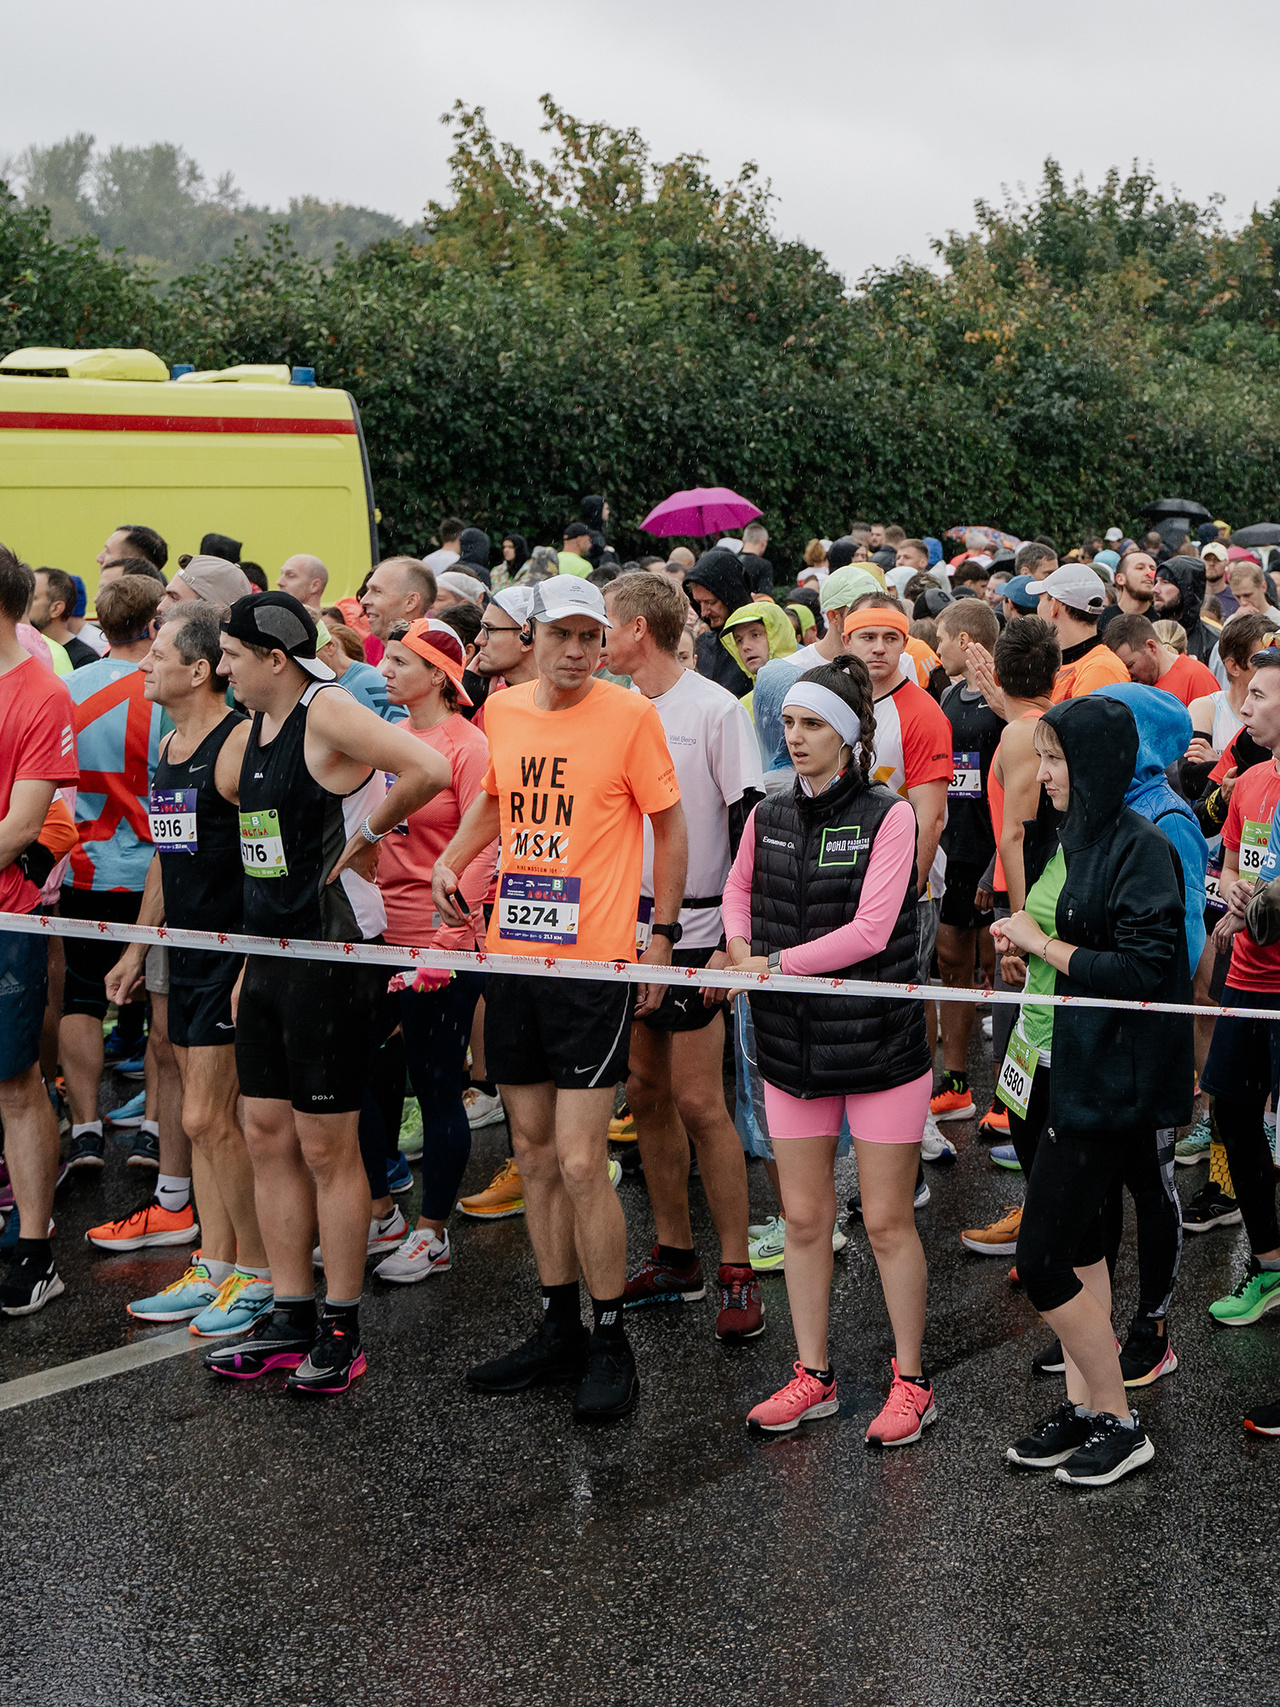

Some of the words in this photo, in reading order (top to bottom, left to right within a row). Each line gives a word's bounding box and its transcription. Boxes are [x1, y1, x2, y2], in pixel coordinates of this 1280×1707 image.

[521, 756, 567, 789] WE
[511, 792, 574, 826] RUN
[153, 819, 182, 837] 5916
[242, 843, 267, 863] 776
[515, 832, 562, 858] MSK
[825, 840, 847, 852] ФОНД
[507, 904, 559, 927] 5274
[1003, 1064, 1024, 1097] 4580
